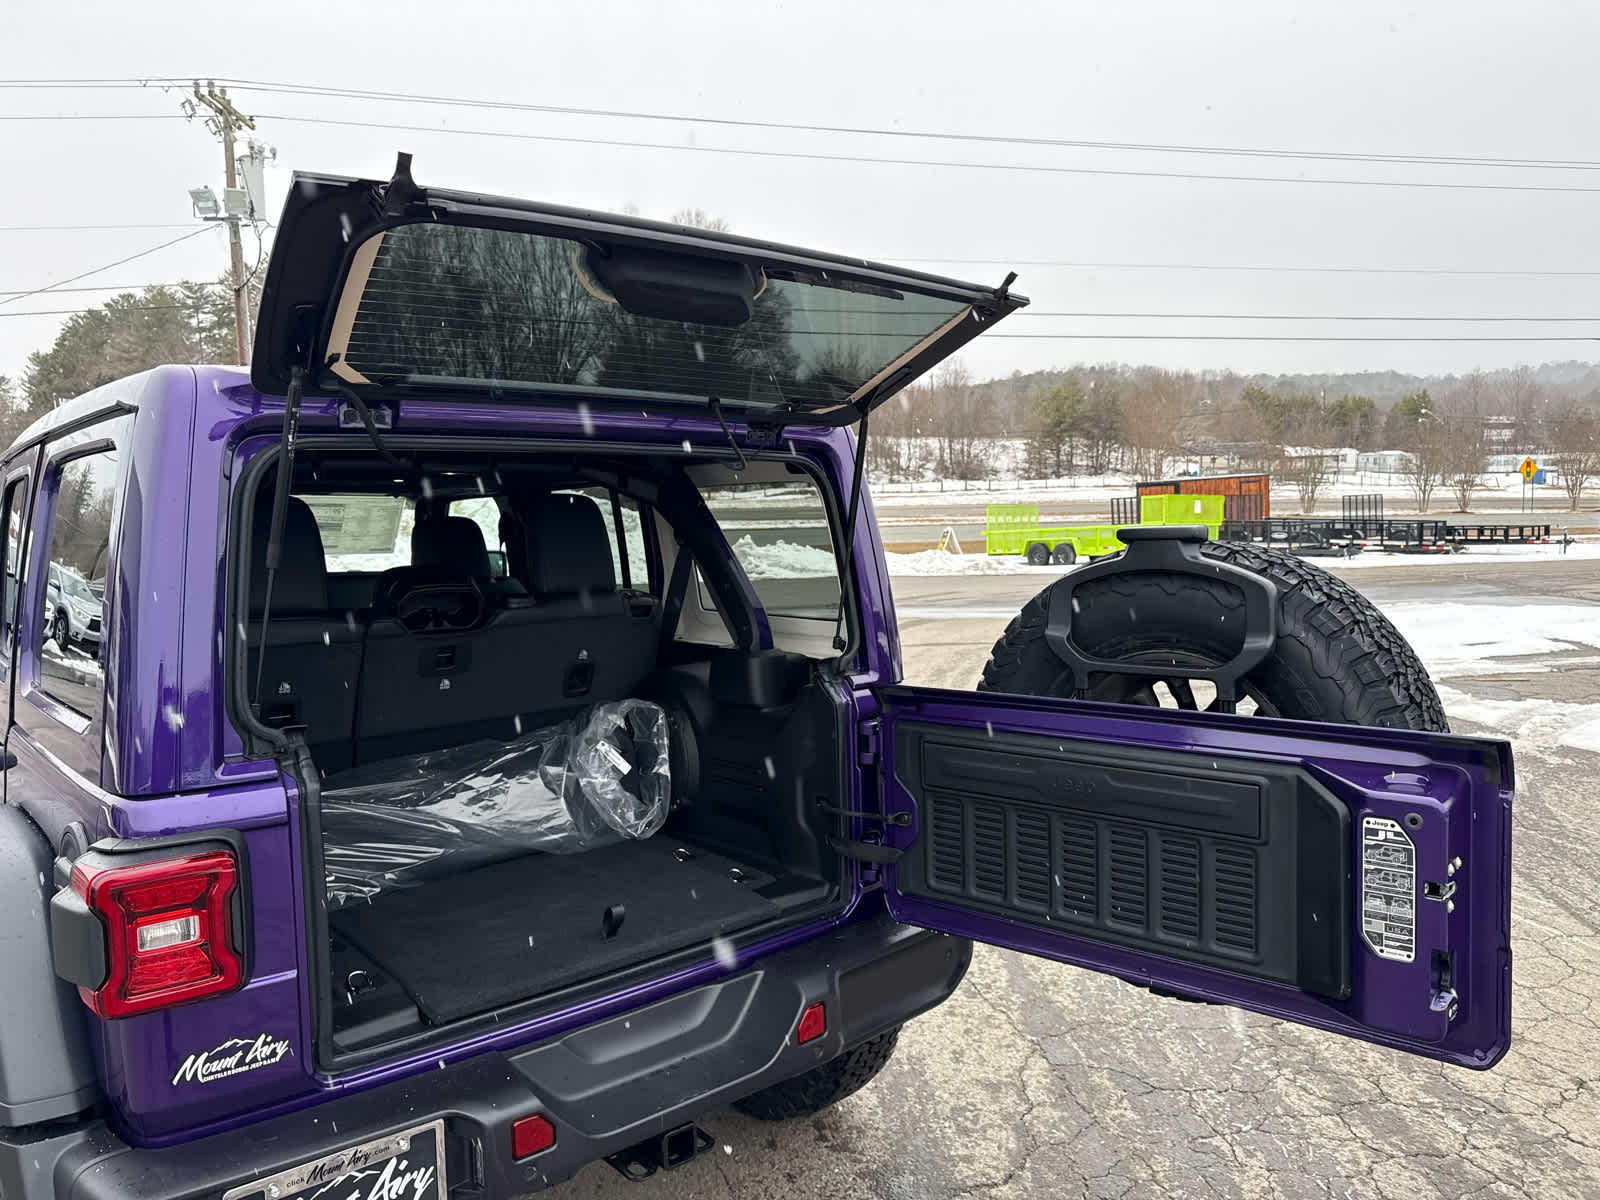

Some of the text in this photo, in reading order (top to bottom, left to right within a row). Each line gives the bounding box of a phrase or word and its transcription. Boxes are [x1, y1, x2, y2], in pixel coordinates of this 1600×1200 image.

[1366, 830, 1407, 841] JL
[172, 1033, 289, 1086] Mount Airy
[286, 1176, 305, 1188] click
[306, 1162, 345, 1184] Mount
[346, 1149, 372, 1167] Airy
[367, 1157, 434, 1200] Airy
